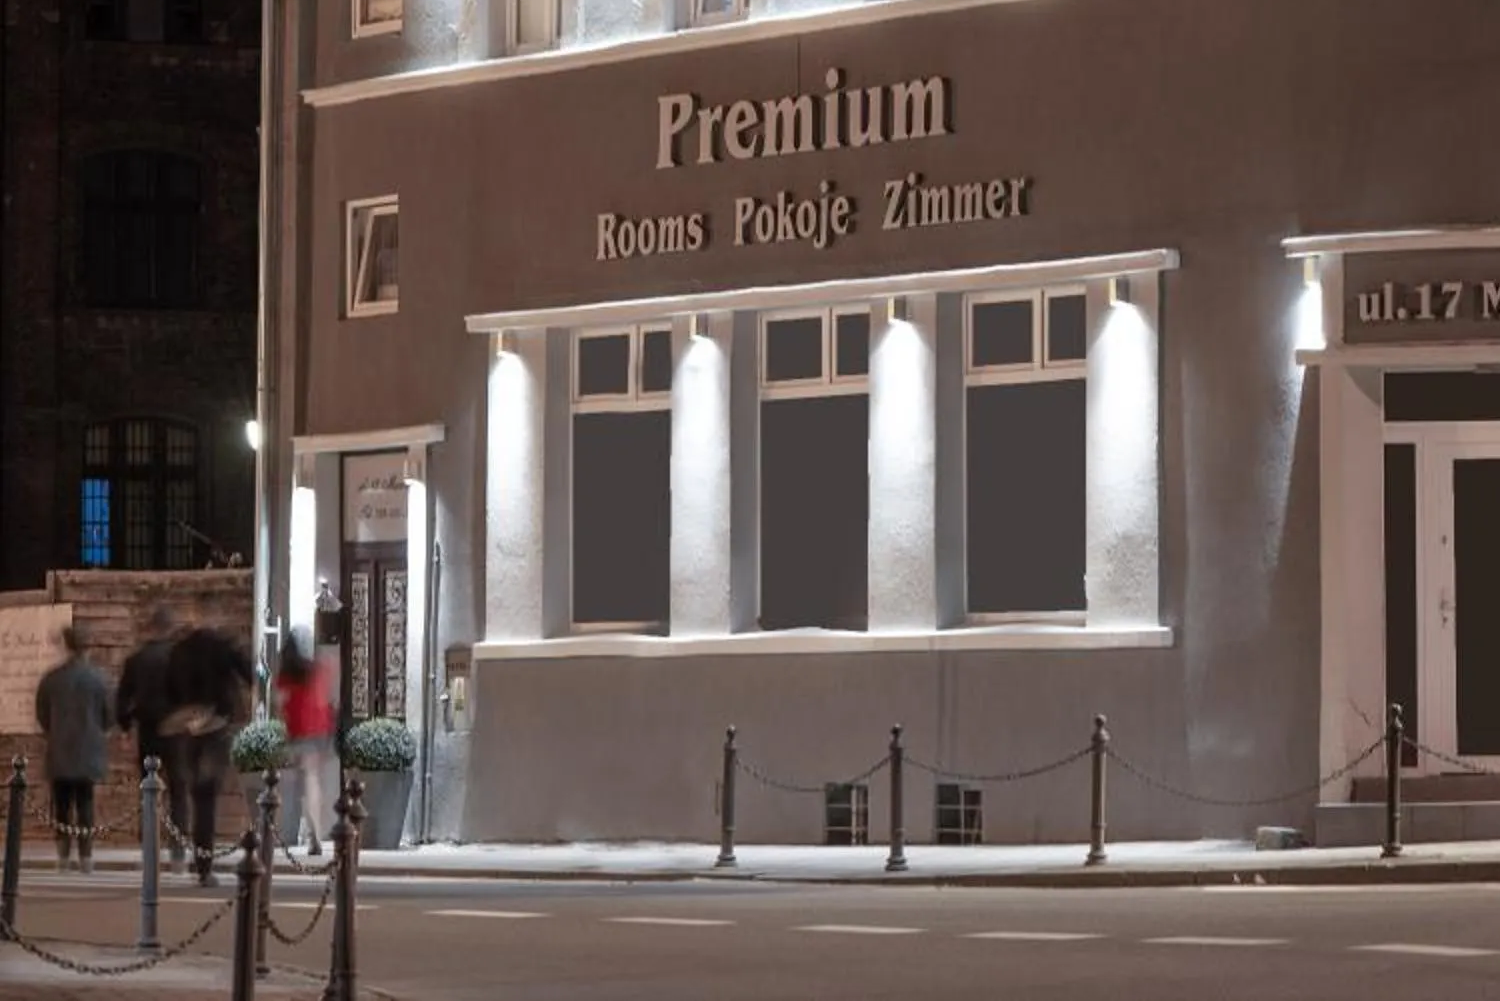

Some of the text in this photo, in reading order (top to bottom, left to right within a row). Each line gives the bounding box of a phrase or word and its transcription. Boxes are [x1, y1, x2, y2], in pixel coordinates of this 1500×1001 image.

[656, 67, 948, 170] Premium
[596, 171, 1026, 261] Rooms Pokoje Zimmer
[1358, 280, 1463, 323] ul.17
